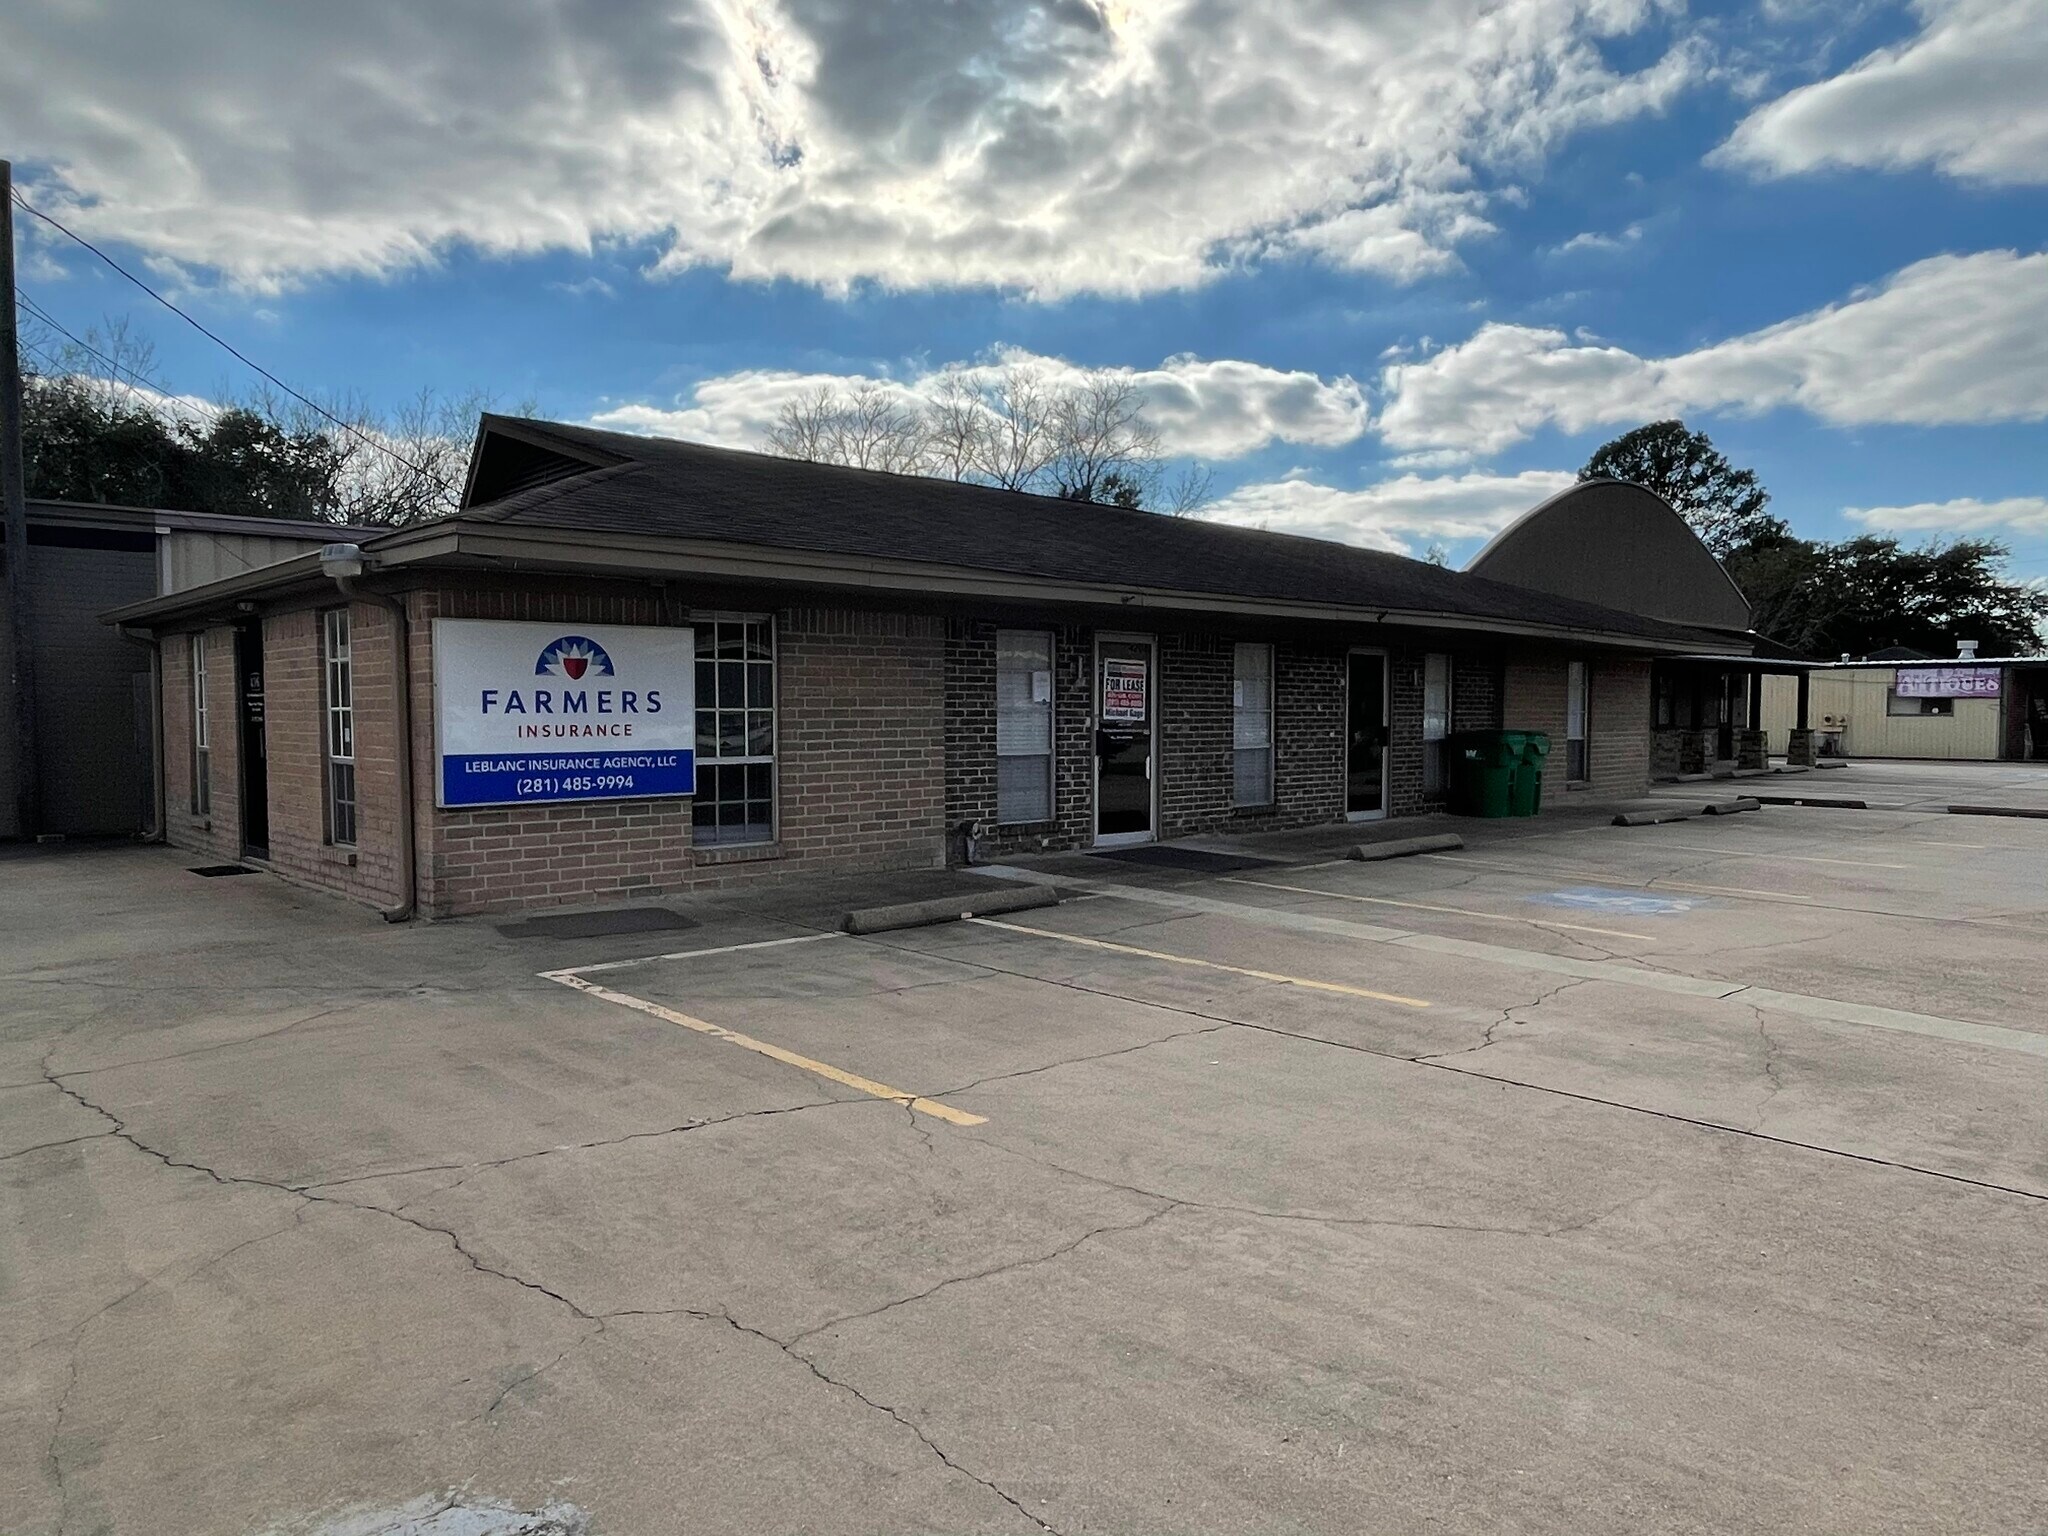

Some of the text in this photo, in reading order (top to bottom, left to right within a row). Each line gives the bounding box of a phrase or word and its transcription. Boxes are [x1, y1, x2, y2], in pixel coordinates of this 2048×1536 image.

[1105, 678, 1144, 691] FOR LEASE
[481, 690, 662, 714] FARMERS
[518, 724, 633, 738] INSURANCE
[465, 755, 677, 773] LEBLANC INSURANCE AGENCY, LLC
[516, 775, 634, 795] (281) 485-9994
